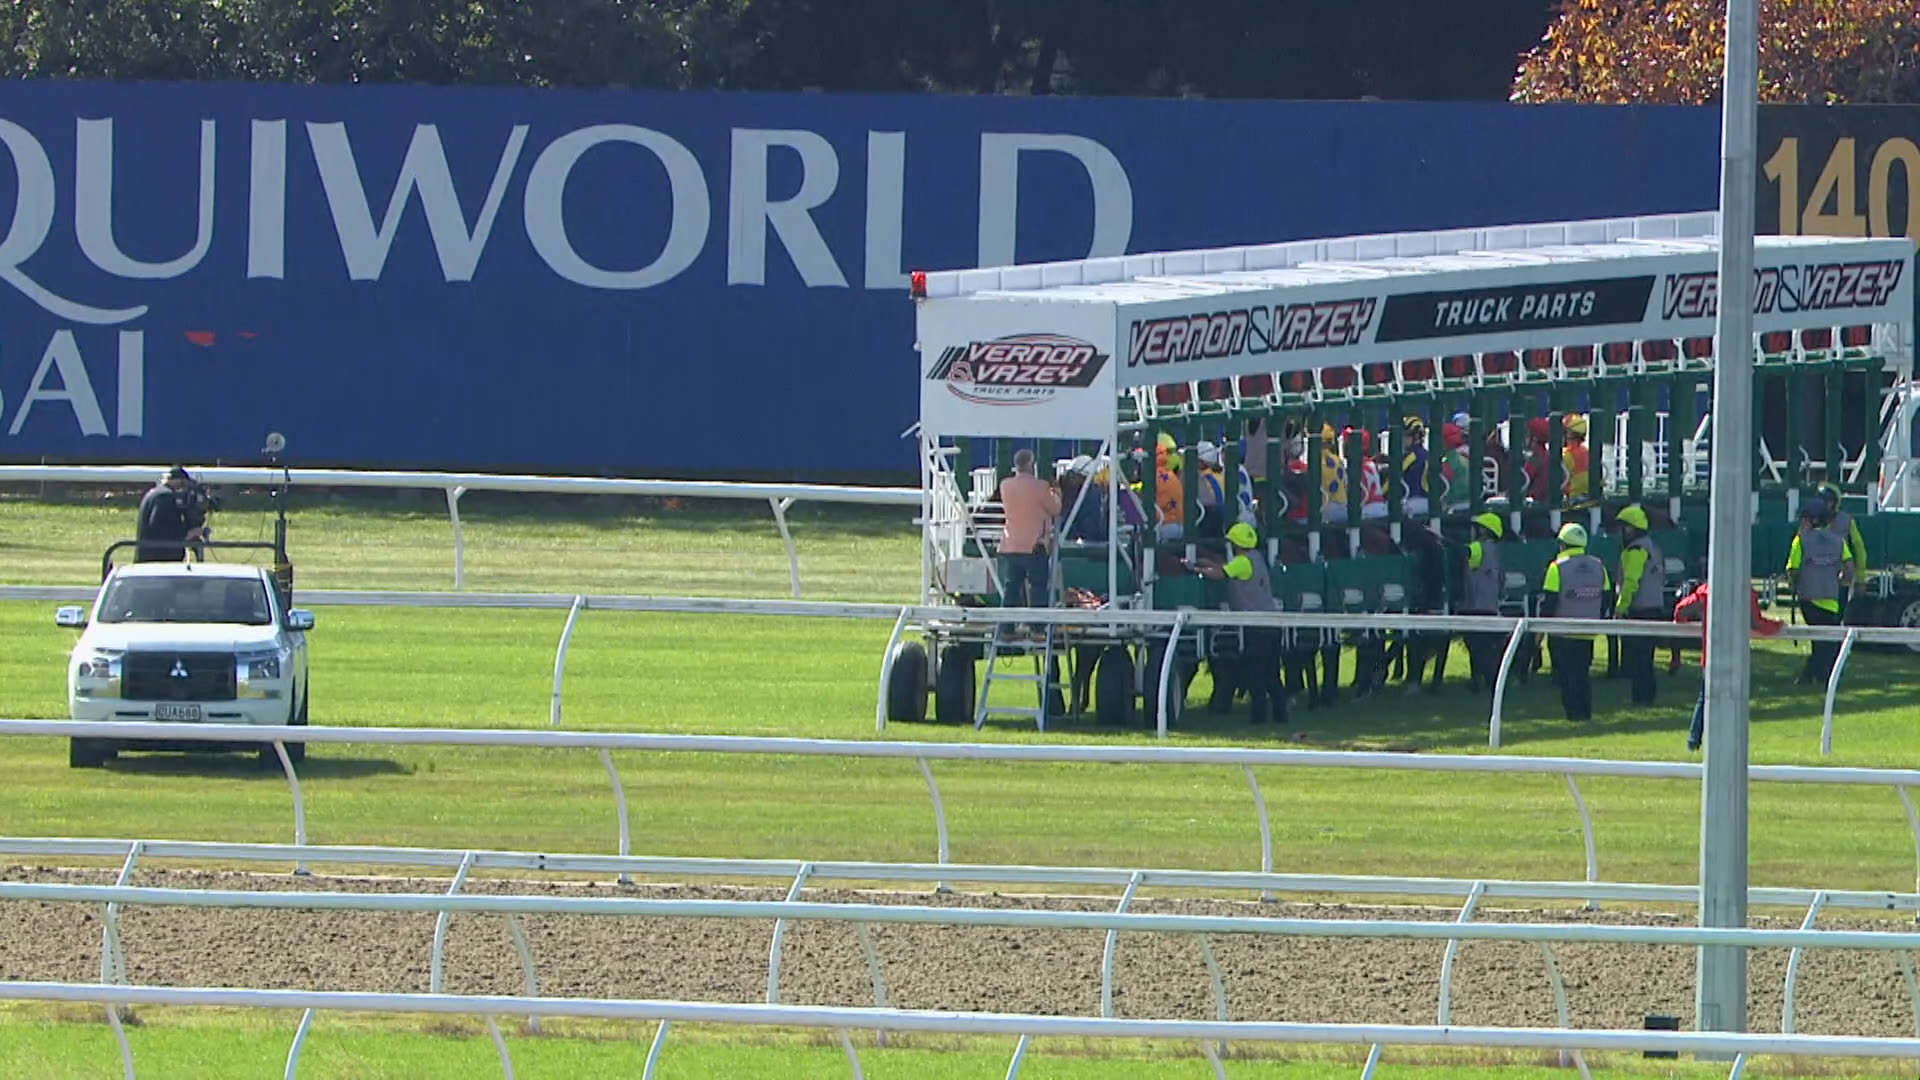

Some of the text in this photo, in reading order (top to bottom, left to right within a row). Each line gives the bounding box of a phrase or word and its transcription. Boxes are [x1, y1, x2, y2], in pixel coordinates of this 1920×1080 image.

[1435, 291, 1595, 328] TRUCK PARTS
[968, 342, 1097, 364] VERNON
[0, 329, 144, 437] AI
[973, 386, 1056, 396] TRUCK PARTS
